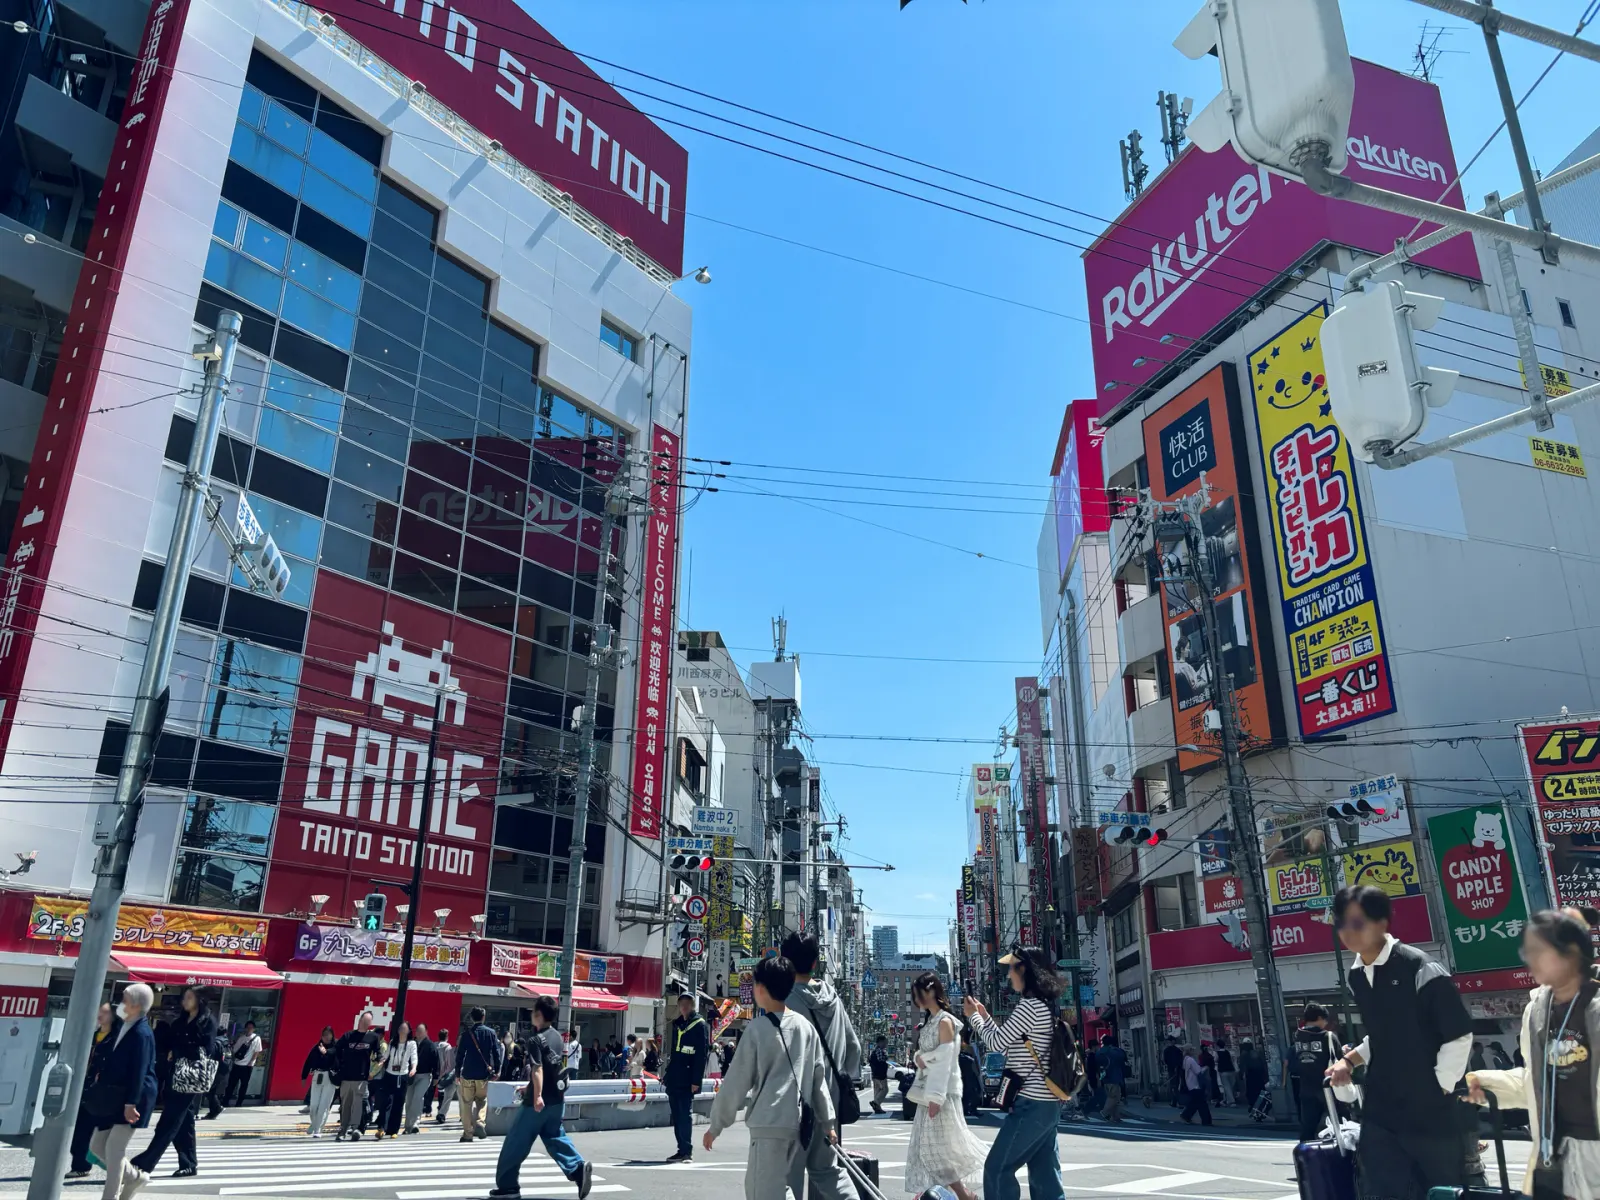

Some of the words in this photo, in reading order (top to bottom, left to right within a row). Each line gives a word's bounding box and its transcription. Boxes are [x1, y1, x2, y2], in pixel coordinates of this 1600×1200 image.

[495, 48, 671, 225] STATION
[1346, 135, 1447, 185] akuten
[1169, 416, 1205, 459] 快活
[1532, 438, 1580, 460] 広告募集
[1171, 445, 1208, 479] CLUB
[1534, 457, 1585, 476] 06-6632-2985
[1276, 442, 1312, 580] チャンピオン
[1296, 432, 1352, 568] トレカ
[650, 519, 669, 620] WELCOME
[1292, 590, 1321, 609] TRADING
[1323, 581, 1341, 595] CARD
[1343, 571, 1361, 586] GAME
[1294, 581, 1365, 627] CHAMPION
[1308, 629, 1326, 647] 4F
[1312, 654, 1329, 670] 3F
[1331, 643, 1351, 664] 買取
[1354, 637, 1374, 655] 販売
[648, 640, 662, 703] 欢迎光临
[1303, 662, 1378, 704] 一番くじ
[1316, 692, 1377, 727] 大量入荷!!
[303, 716, 483, 840] GAME
[1349, 775, 1397, 798] 歩車分離式
[1550, 777, 1577, 798] 24
[697, 810, 734, 825] 難波中2
[1100, 812, 1151, 825] 歩車分離式
[300, 821, 373, 860] TAITO
[667, 837, 712, 849] 歩車分離式
[1449, 853, 1501, 879] CANDY
[1456, 875, 1504, 899] APPLE
[1471, 897, 1495, 911] SHOP
[966, 905, 975, 941] カラオケ
[1454, 919, 1523, 943] もりくま
[299, 934, 318, 950] 6F
[374, 938, 466, 966] 最新種稼働中!
[493, 947, 519, 959] FLOOR
[691, 942, 700, 951] 40
[493, 958, 519, 970] GUIDE
